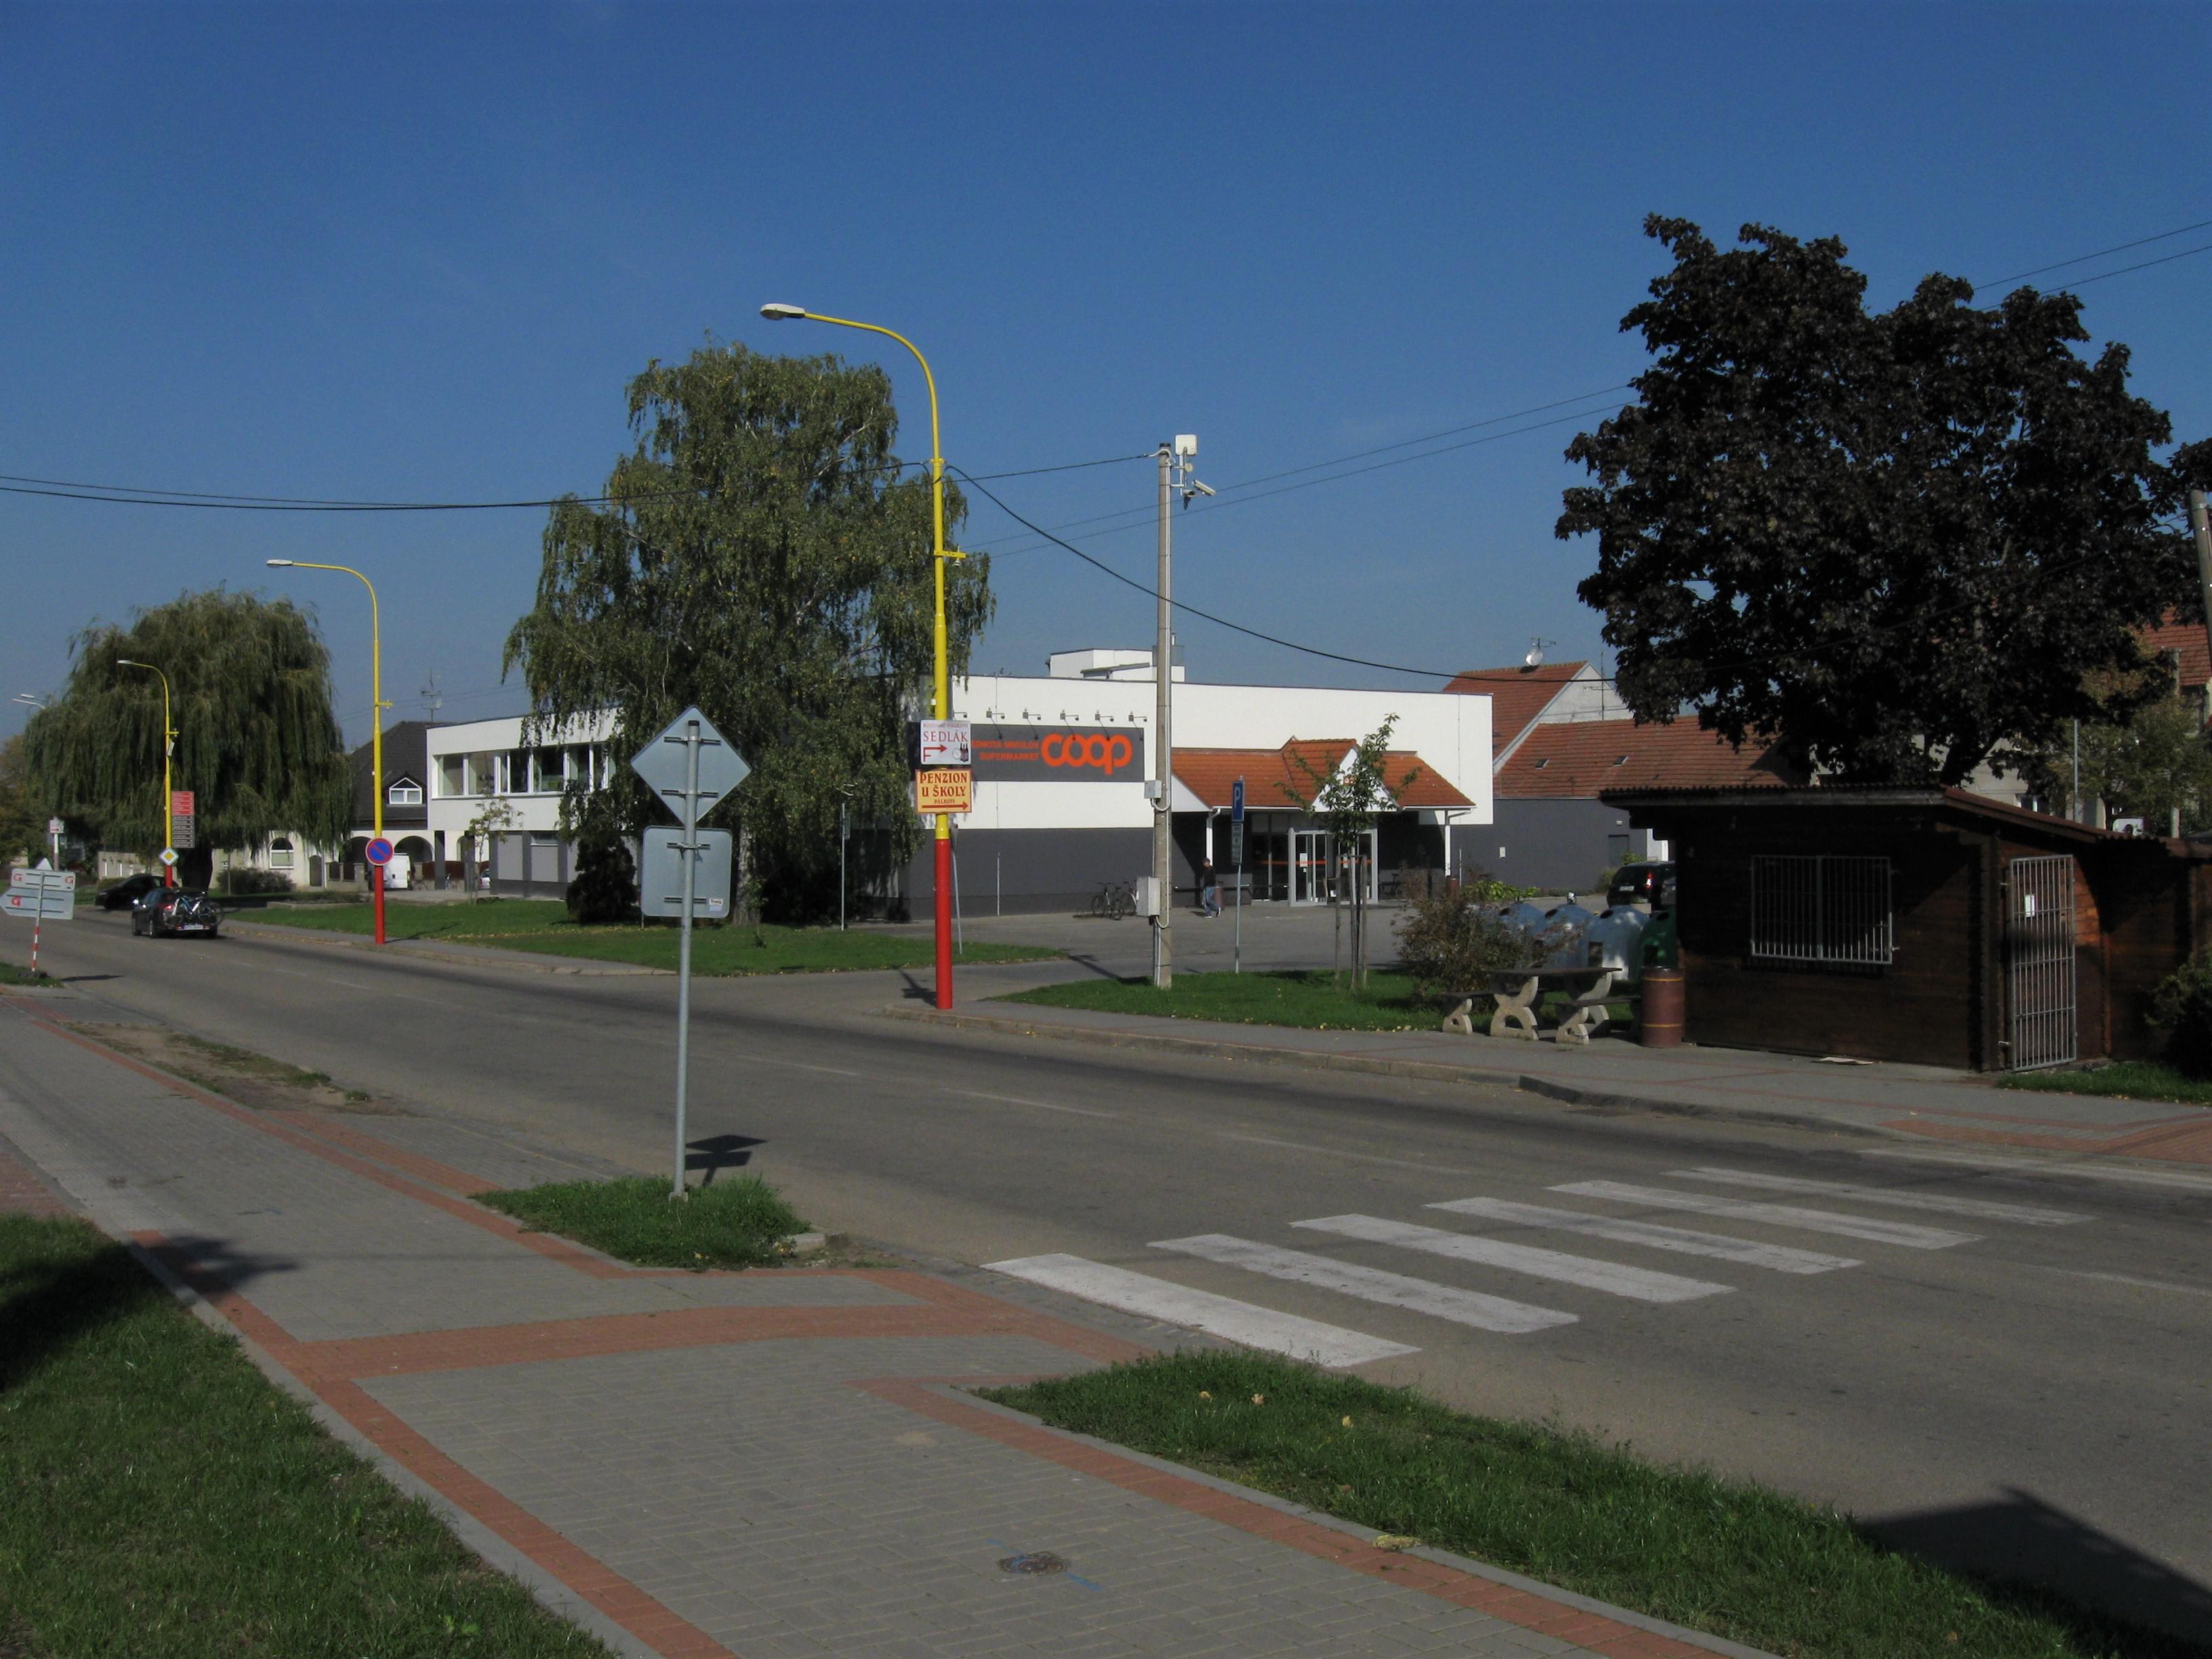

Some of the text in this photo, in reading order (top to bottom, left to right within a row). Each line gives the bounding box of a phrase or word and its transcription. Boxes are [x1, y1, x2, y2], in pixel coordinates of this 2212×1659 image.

[923, 730, 968, 742] SEDLÁK
[979, 752, 1039, 760] SUPERMARKET
[920, 772, 967, 783] PENZION
[933, 785, 966, 797] ŠKOLY
